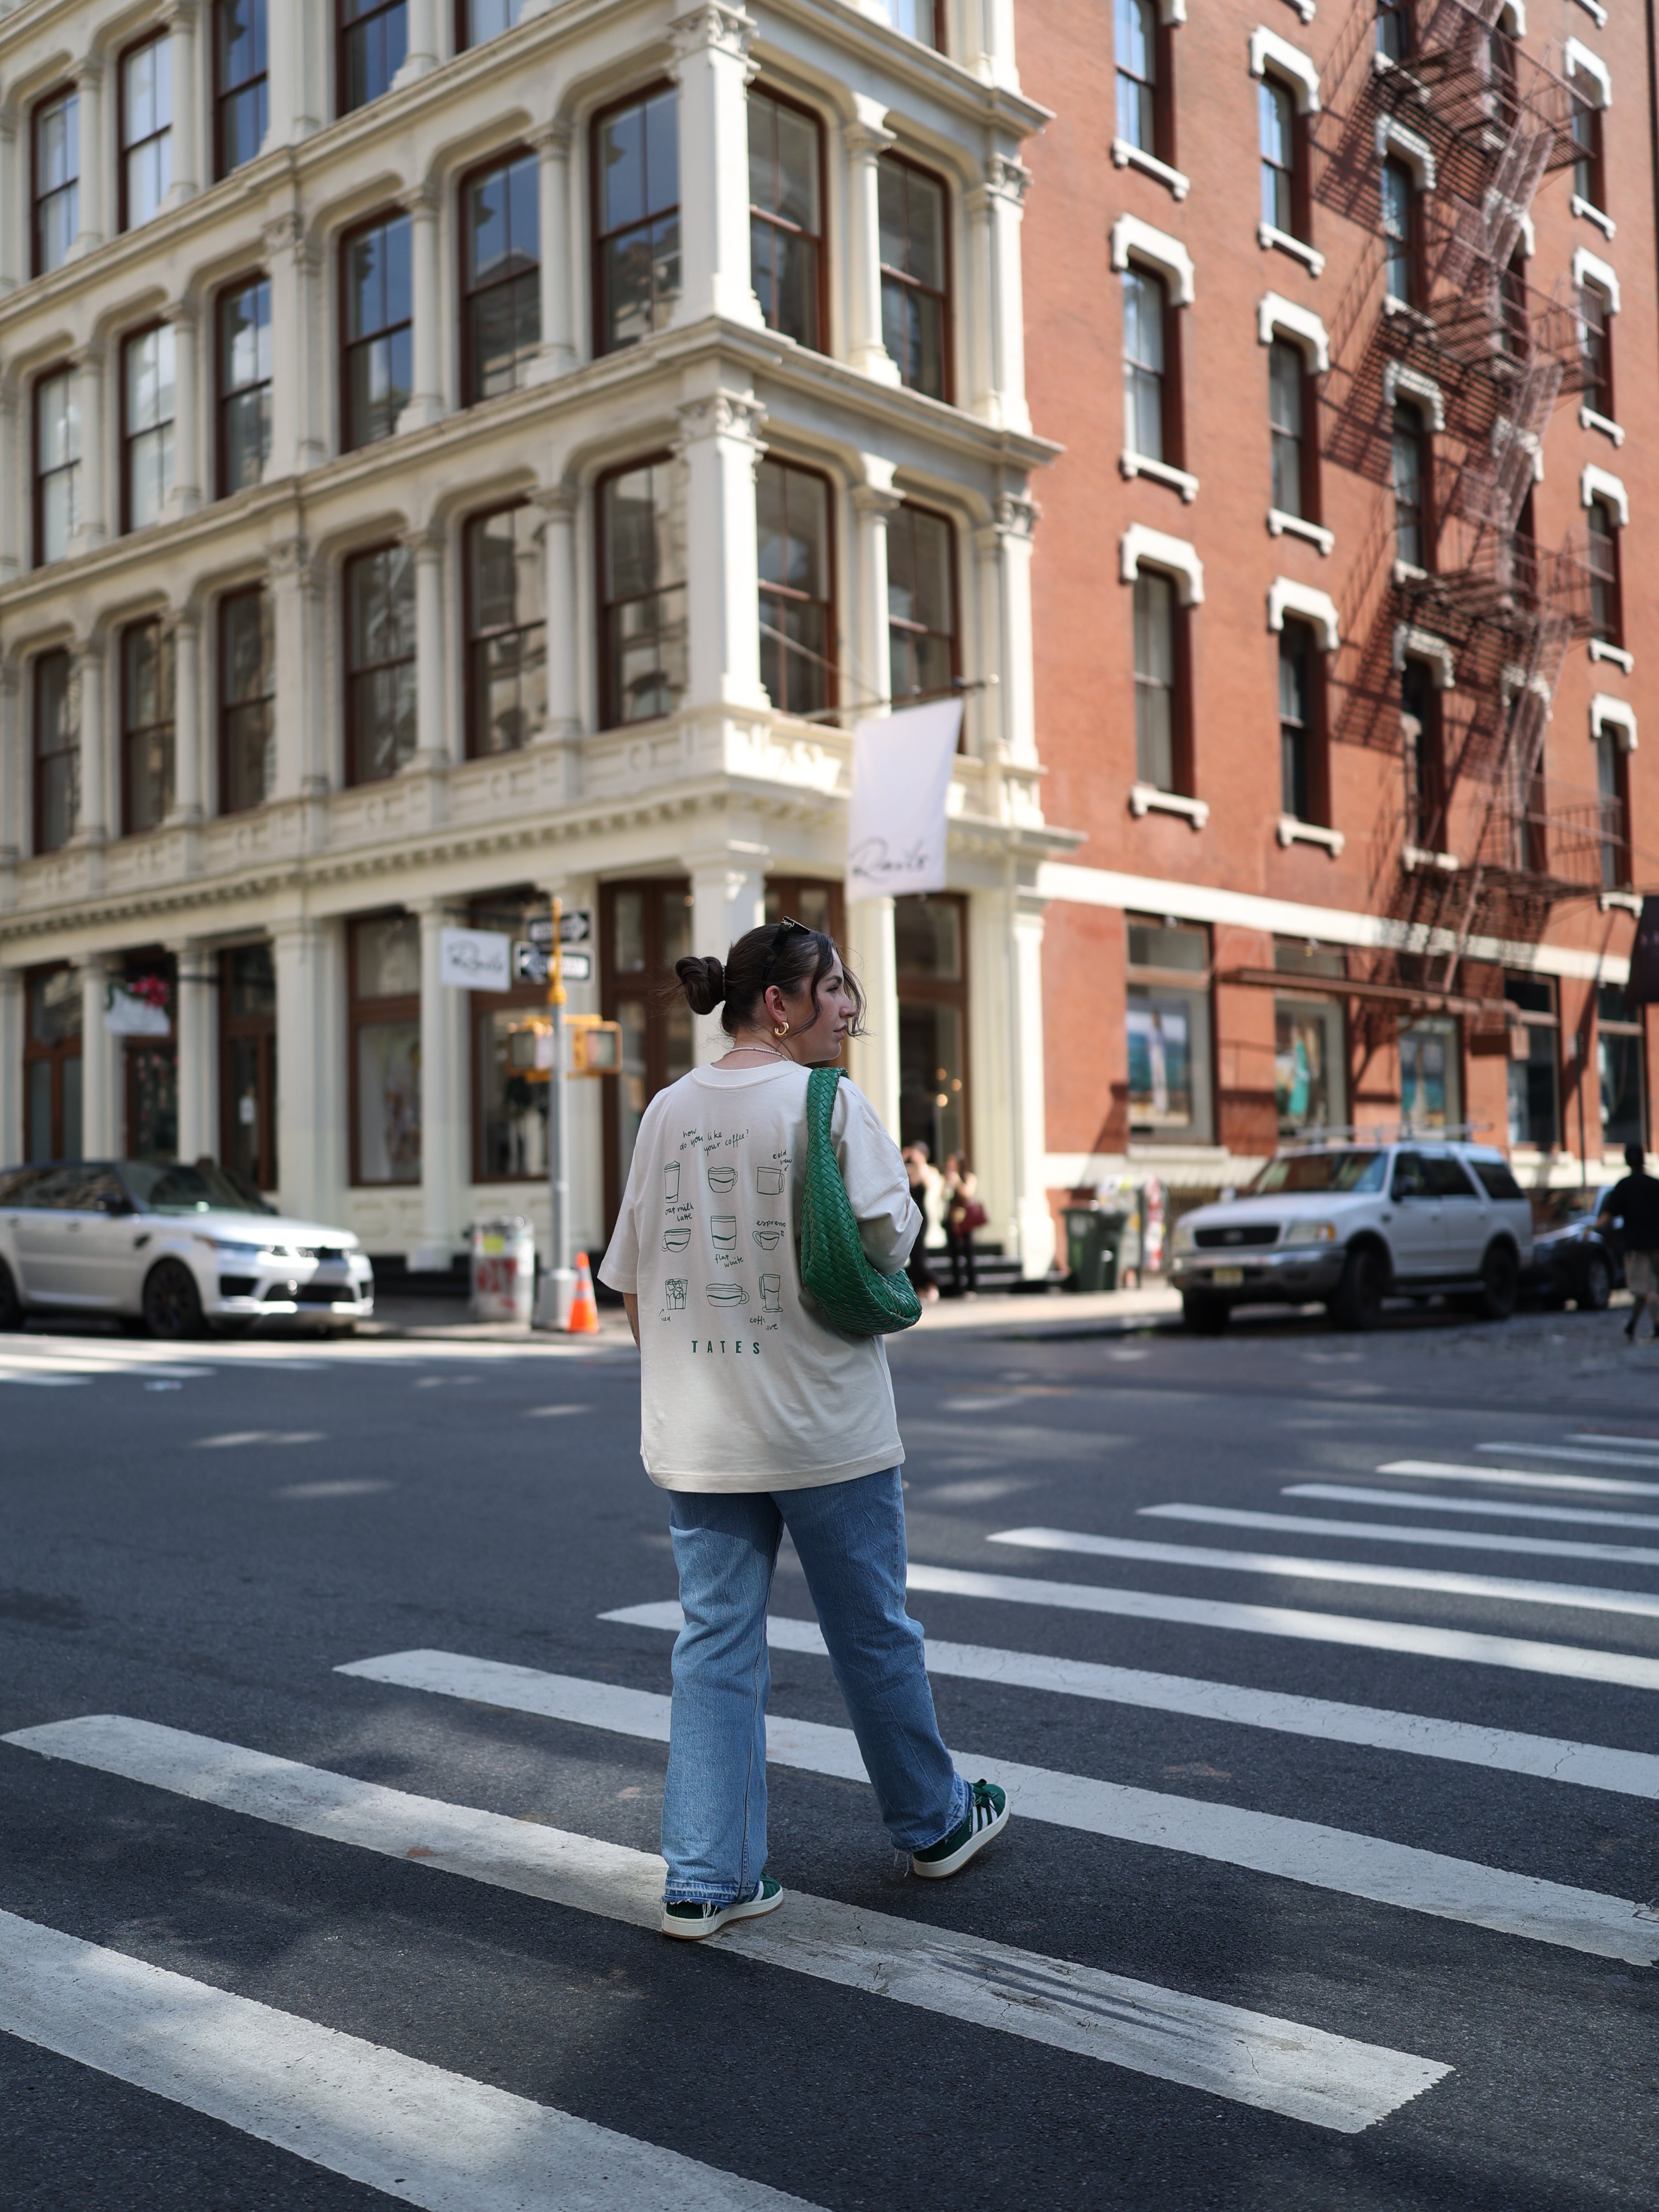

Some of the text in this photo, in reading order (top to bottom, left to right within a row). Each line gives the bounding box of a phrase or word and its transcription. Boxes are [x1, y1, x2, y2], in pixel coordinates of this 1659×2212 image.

[683, 1128, 697, 1138] how
[679, 1130, 723, 1151] do you like
[704, 1129, 749, 1156] your coffee?
[773, 1149, 787, 1159] cold
[665, 1202, 694, 1216] oat milk
[677, 1213, 693, 1222] latte
[714, 1253, 729, 1264] flat
[724, 1256, 744, 1267] white
[691, 1340, 760, 1354] TATES
